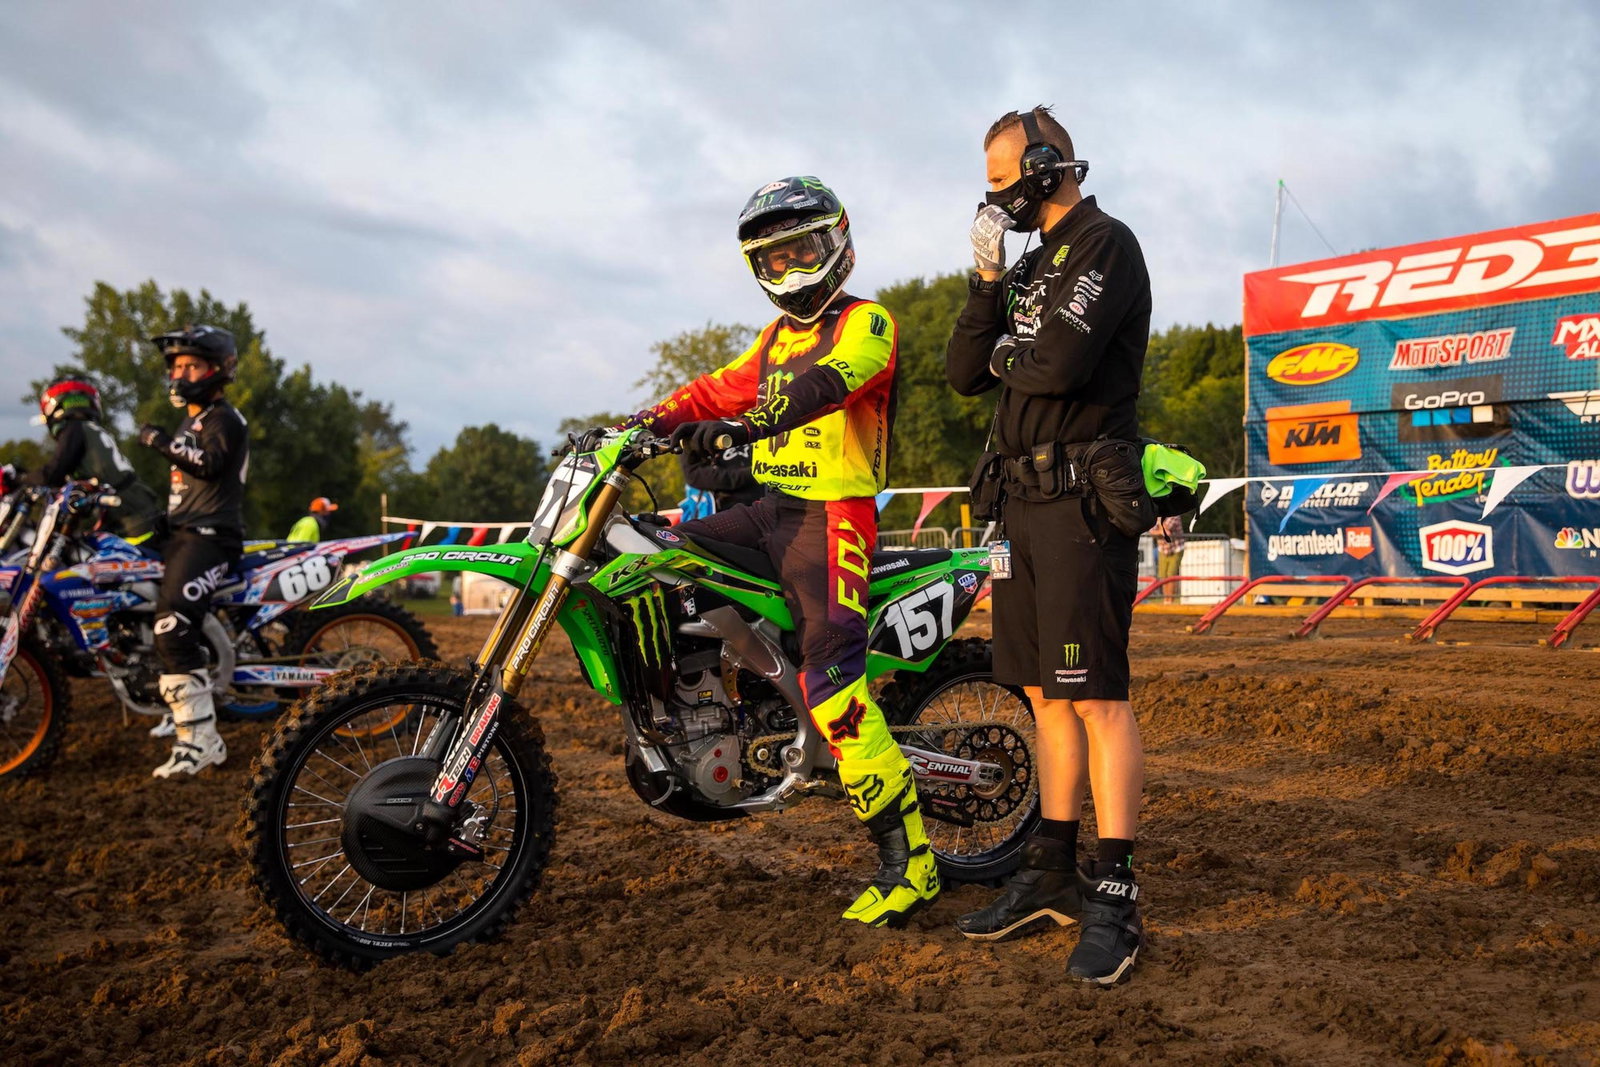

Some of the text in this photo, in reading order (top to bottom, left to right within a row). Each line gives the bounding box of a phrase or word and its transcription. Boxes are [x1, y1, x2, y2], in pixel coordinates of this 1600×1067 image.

[1060, 307, 1091, 333] MONSTER
[1268, 348, 1360, 378] FMF
[1405, 391, 1485, 410] GoPro
[1284, 420, 1341, 449] KTM
[1427, 448, 1498, 473] Battery
[1279, 482, 1369, 500] DNLOP
[1409, 471, 1485, 507] Tender
[442, 551, 523, 565] CIRCUIT
[1267, 527, 1371, 561] guaranteed Rate
[1430, 533, 1483, 562] 100%
[279, 555, 331, 603] 68
[607, 556, 650, 587] KX
[871, 558, 910, 575] awasaki
[511, 639, 532, 670] PRO
[528, 582, 560, 640] CIRCUIT
[884, 580, 954, 660] 157
[276, 671, 315, 680] YAMAHA
[470, 693, 500, 746] BRAKING
[477, 721, 499, 758] PISTONS
[1096, 880, 1129, 897] FOX
